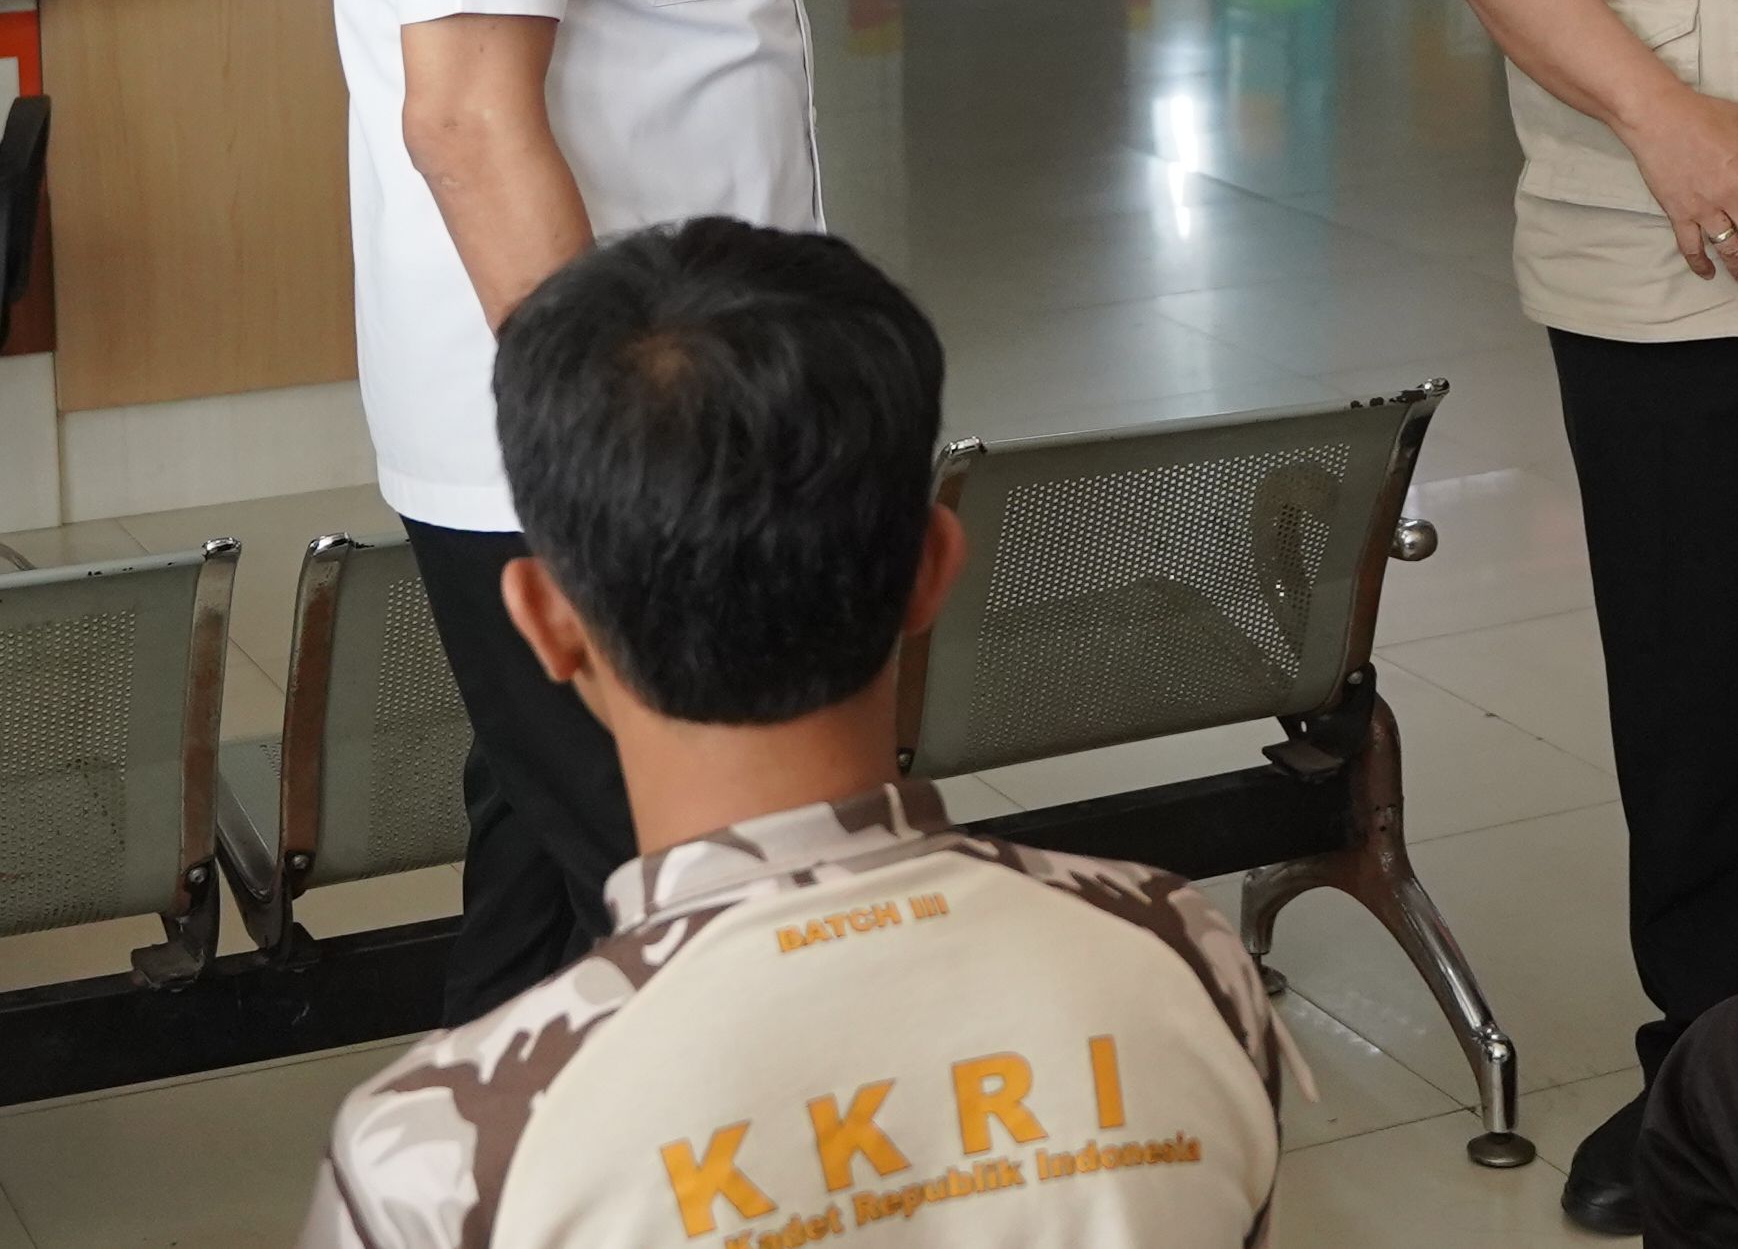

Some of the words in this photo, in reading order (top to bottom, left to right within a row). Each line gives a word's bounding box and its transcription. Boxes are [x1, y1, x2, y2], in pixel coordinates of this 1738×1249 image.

[776, 898, 901, 953] BATCH
[908, 892, 949, 918] III
[852, 1158, 1026, 1226] Republik
[1036, 1130, 1201, 1182] Indonesia
